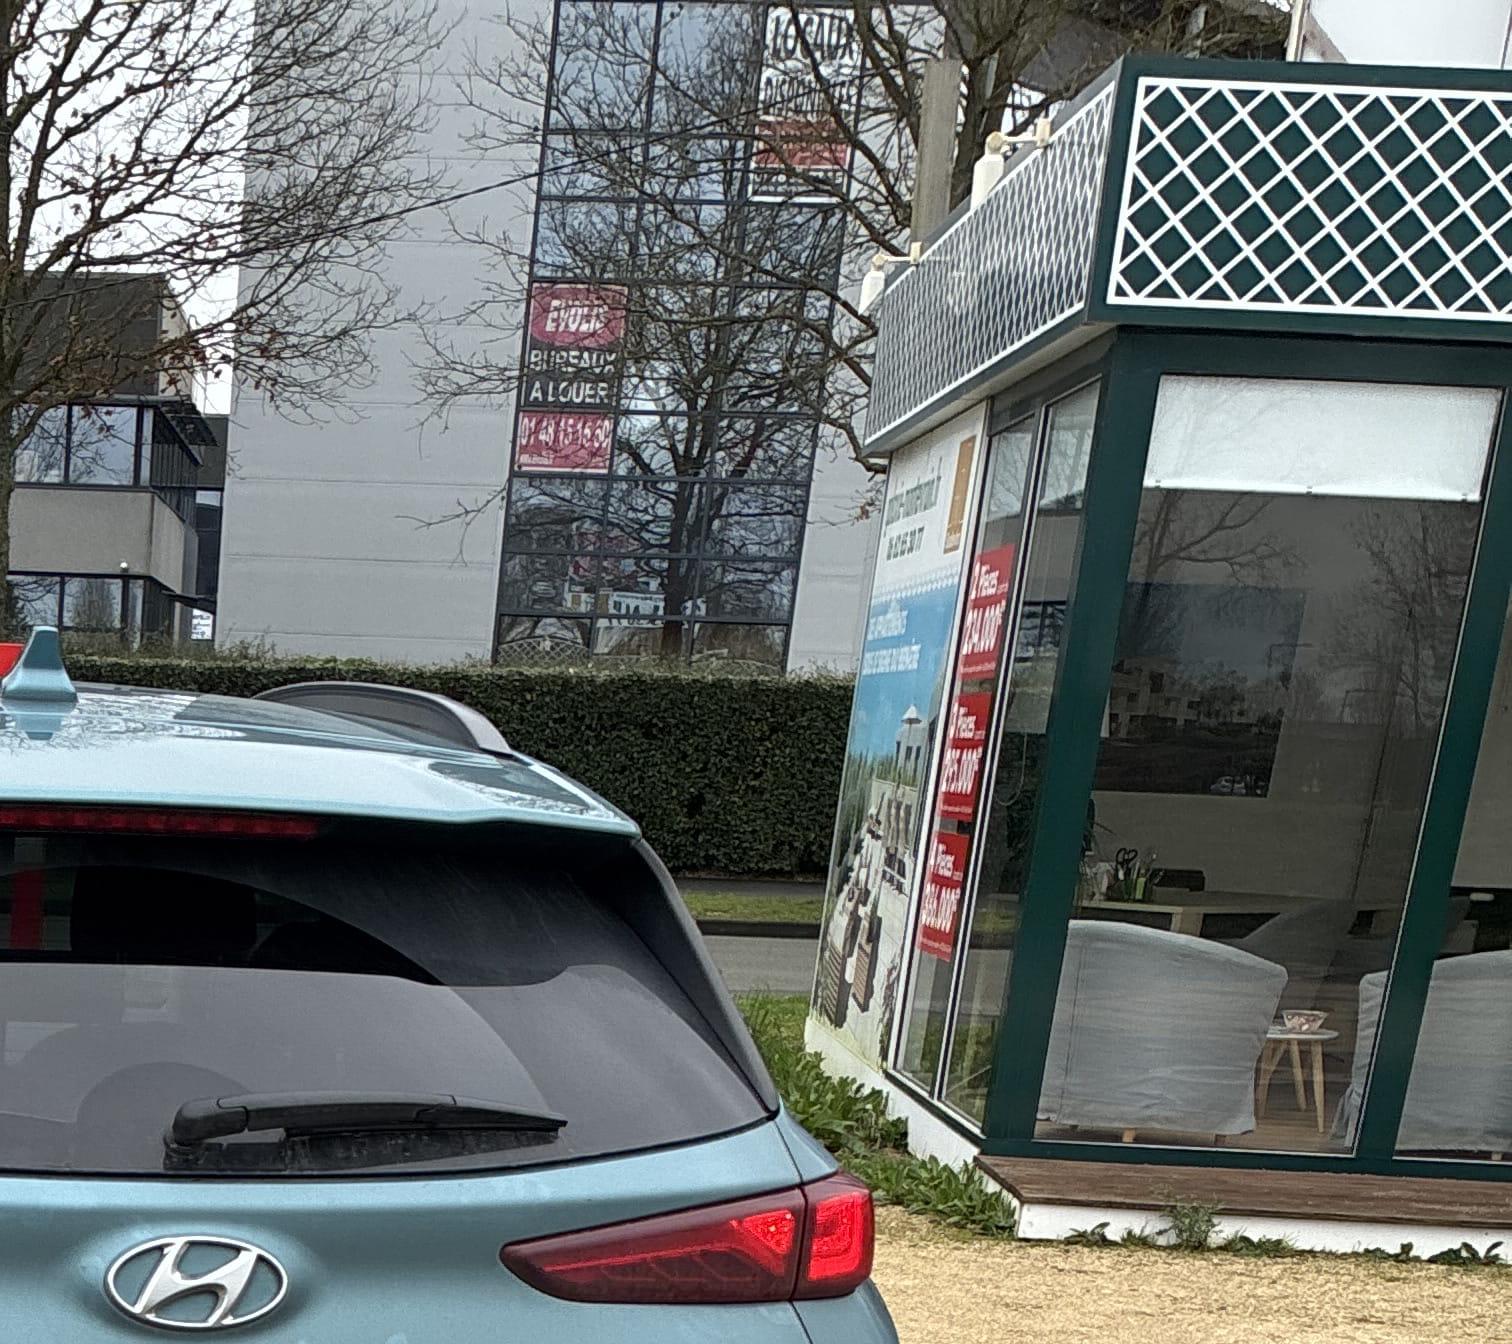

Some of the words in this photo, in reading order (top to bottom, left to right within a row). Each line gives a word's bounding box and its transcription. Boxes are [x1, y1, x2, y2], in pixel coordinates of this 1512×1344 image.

[545, 299, 609, 333] EVOLIS
[529, 350, 616, 374] BUREAUX
[529, 381, 544, 402] A
[548, 381, 609, 404] LOUER
